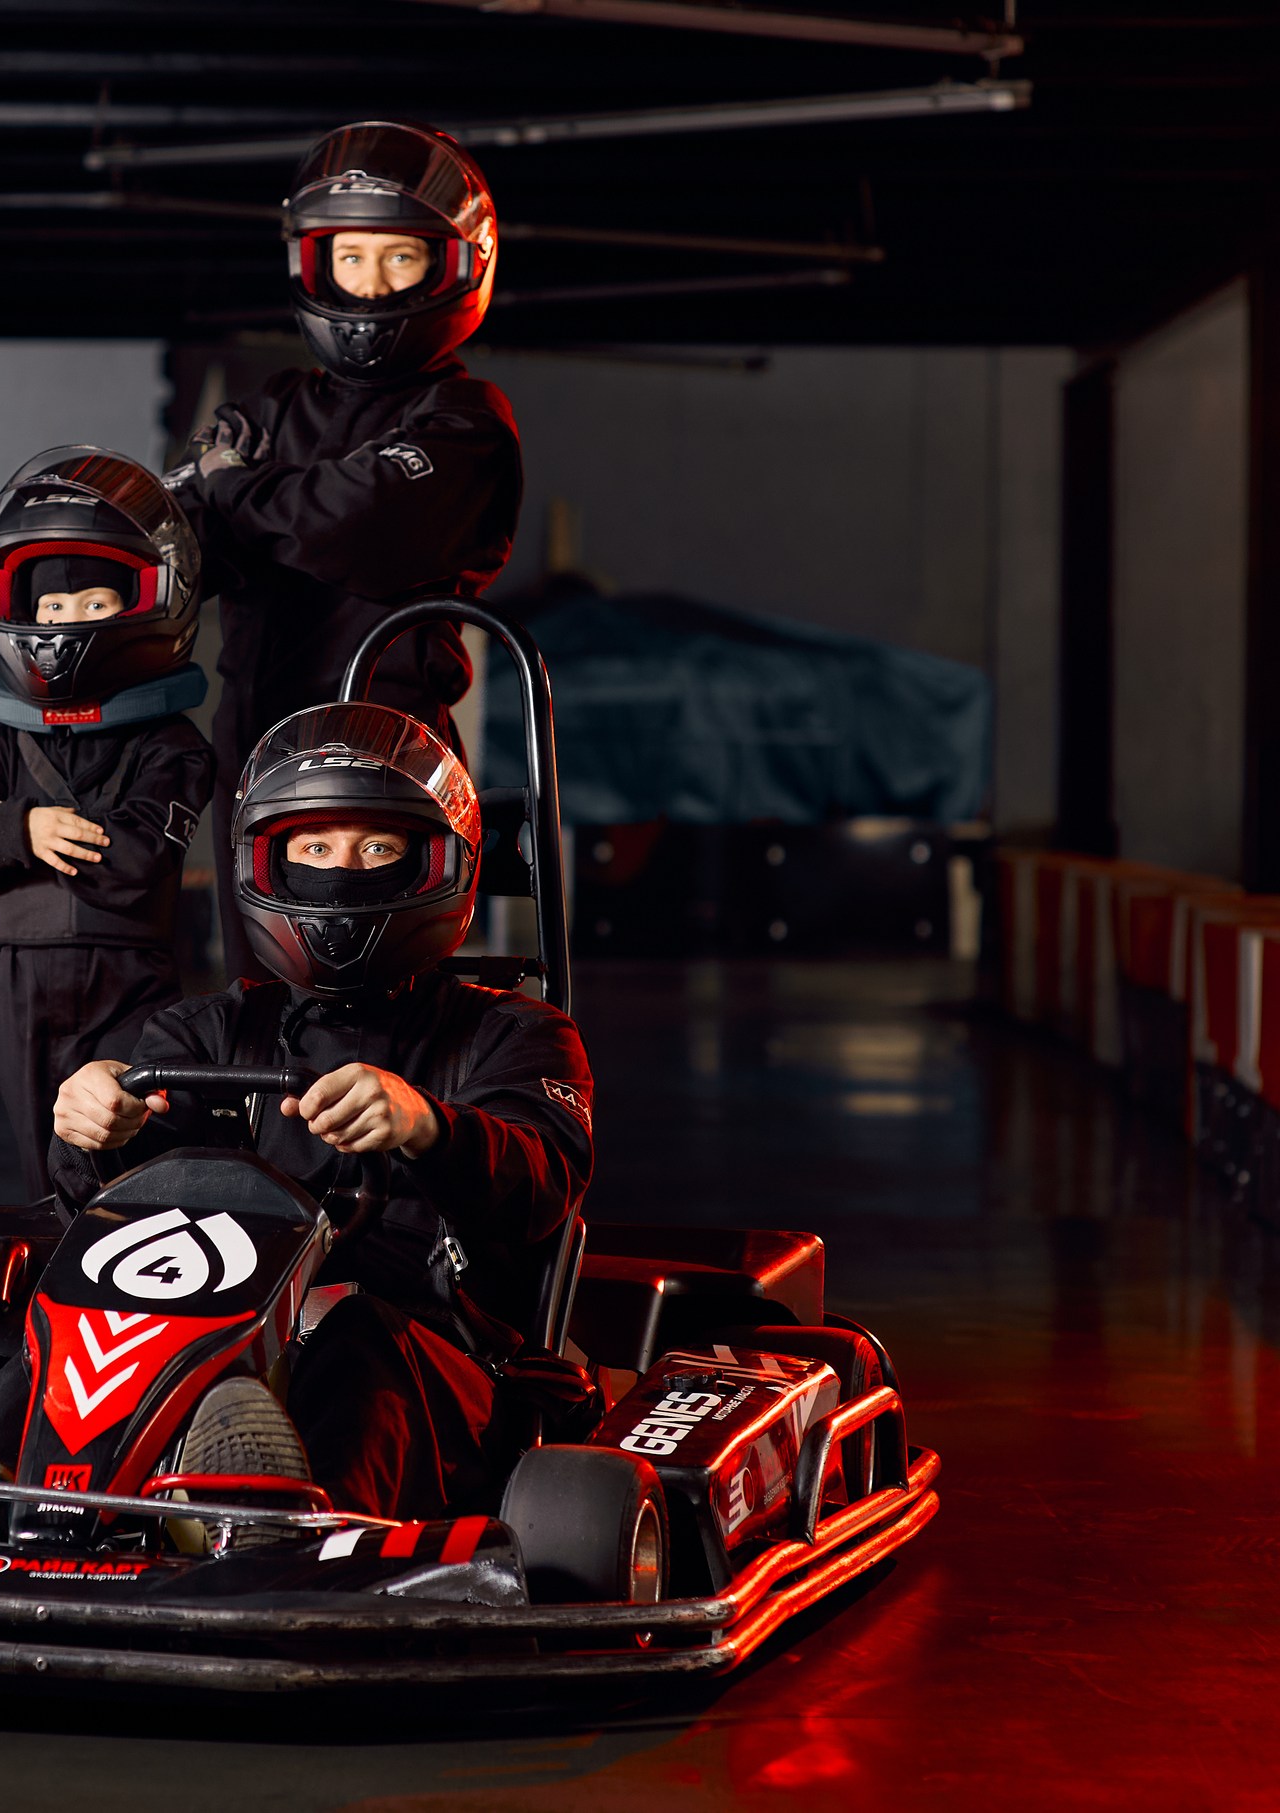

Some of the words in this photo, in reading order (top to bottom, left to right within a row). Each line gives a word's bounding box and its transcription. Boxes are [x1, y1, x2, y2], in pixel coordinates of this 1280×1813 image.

[24, 493, 100, 508] LS2
[298, 756, 383, 772] LS2
[136, 1256, 183, 1284] 4
[620, 1388, 726, 1456] GENES
[80, 1561, 150, 1575] КАРТ
[28, 1570, 85, 1580] академия
[86, 1573, 138, 1582] картинга
